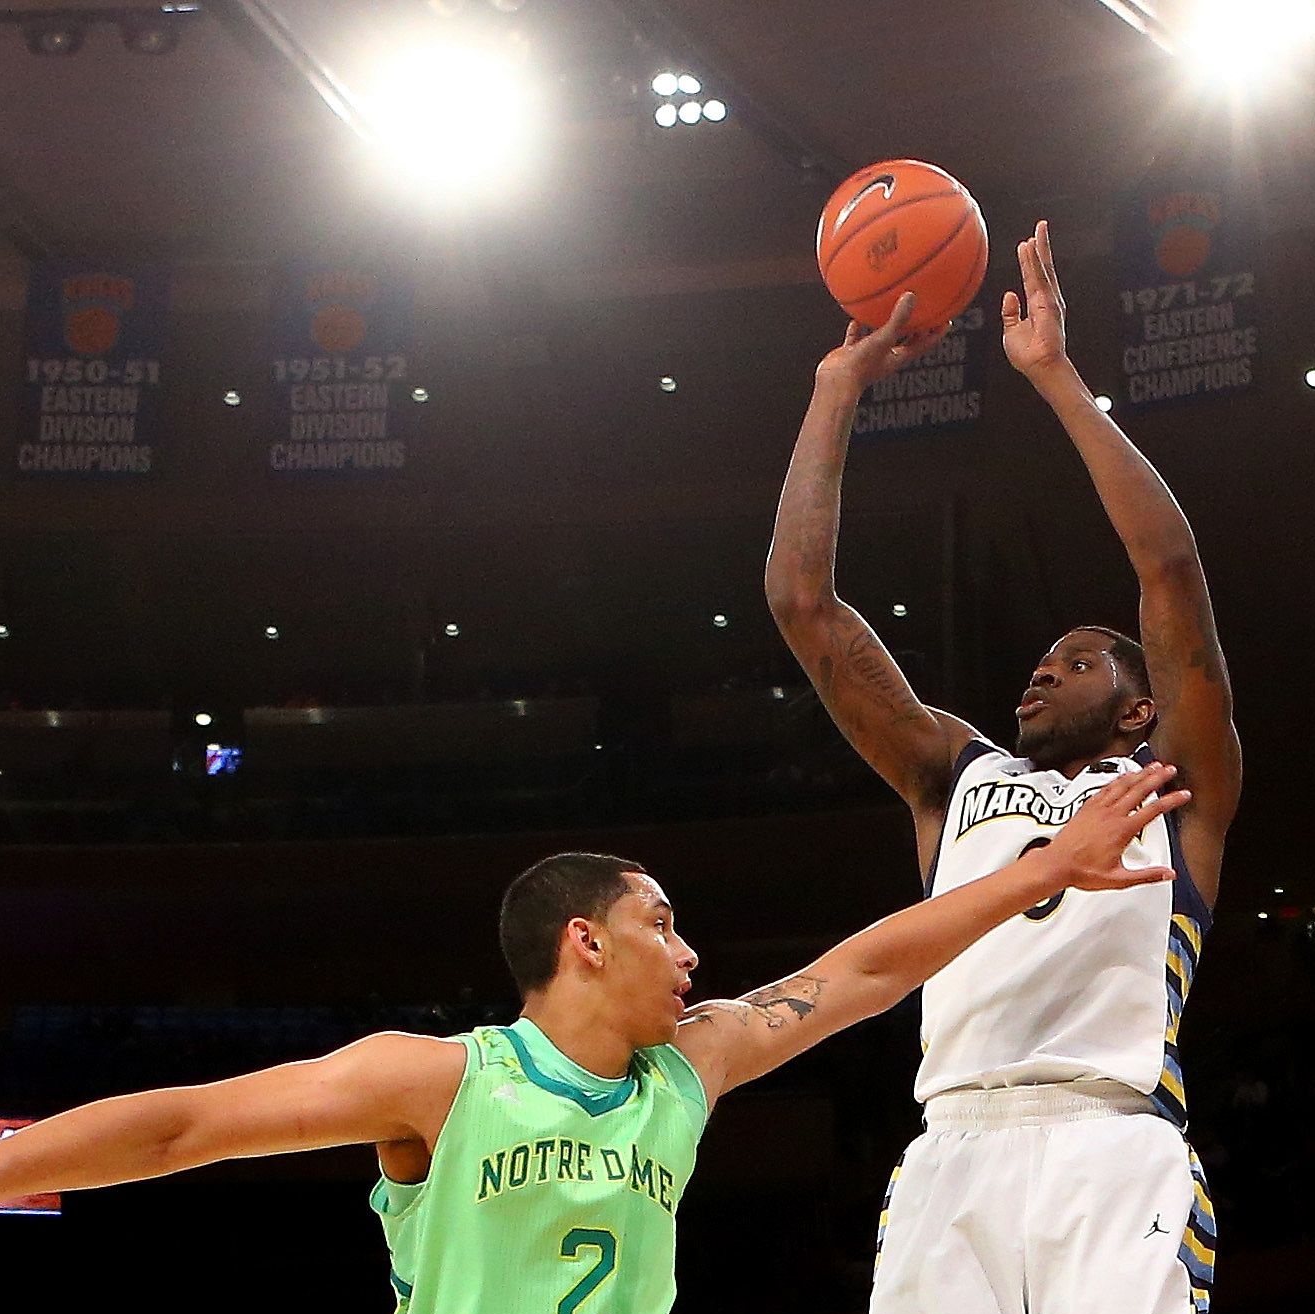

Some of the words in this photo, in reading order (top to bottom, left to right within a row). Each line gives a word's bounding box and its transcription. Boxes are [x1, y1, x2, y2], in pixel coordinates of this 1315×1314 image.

[1120, 272, 1255, 314] 1971-72
[1144, 301, 1233, 341] EASTERN
[1123, 325, 1257, 375] CONFERENCE
[27, 359, 160, 384] 1950-51
[270, 353, 406, 383] 1951-52
[1129, 357, 1252, 404] CHAMPIONS
[41, 385, 139, 414] EASTERN
[291, 383, 388, 411] EASTERN
[854, 390, 981, 434] CHAMPIONS
[39, 415, 136, 443] DIVISION
[290, 412, 387, 440] DIVISION
[18, 442, 151, 473] CHAMPIONS
[269, 440, 405, 471] CHAMPIONS
[475, 1136, 594, 1205] NOTRE
